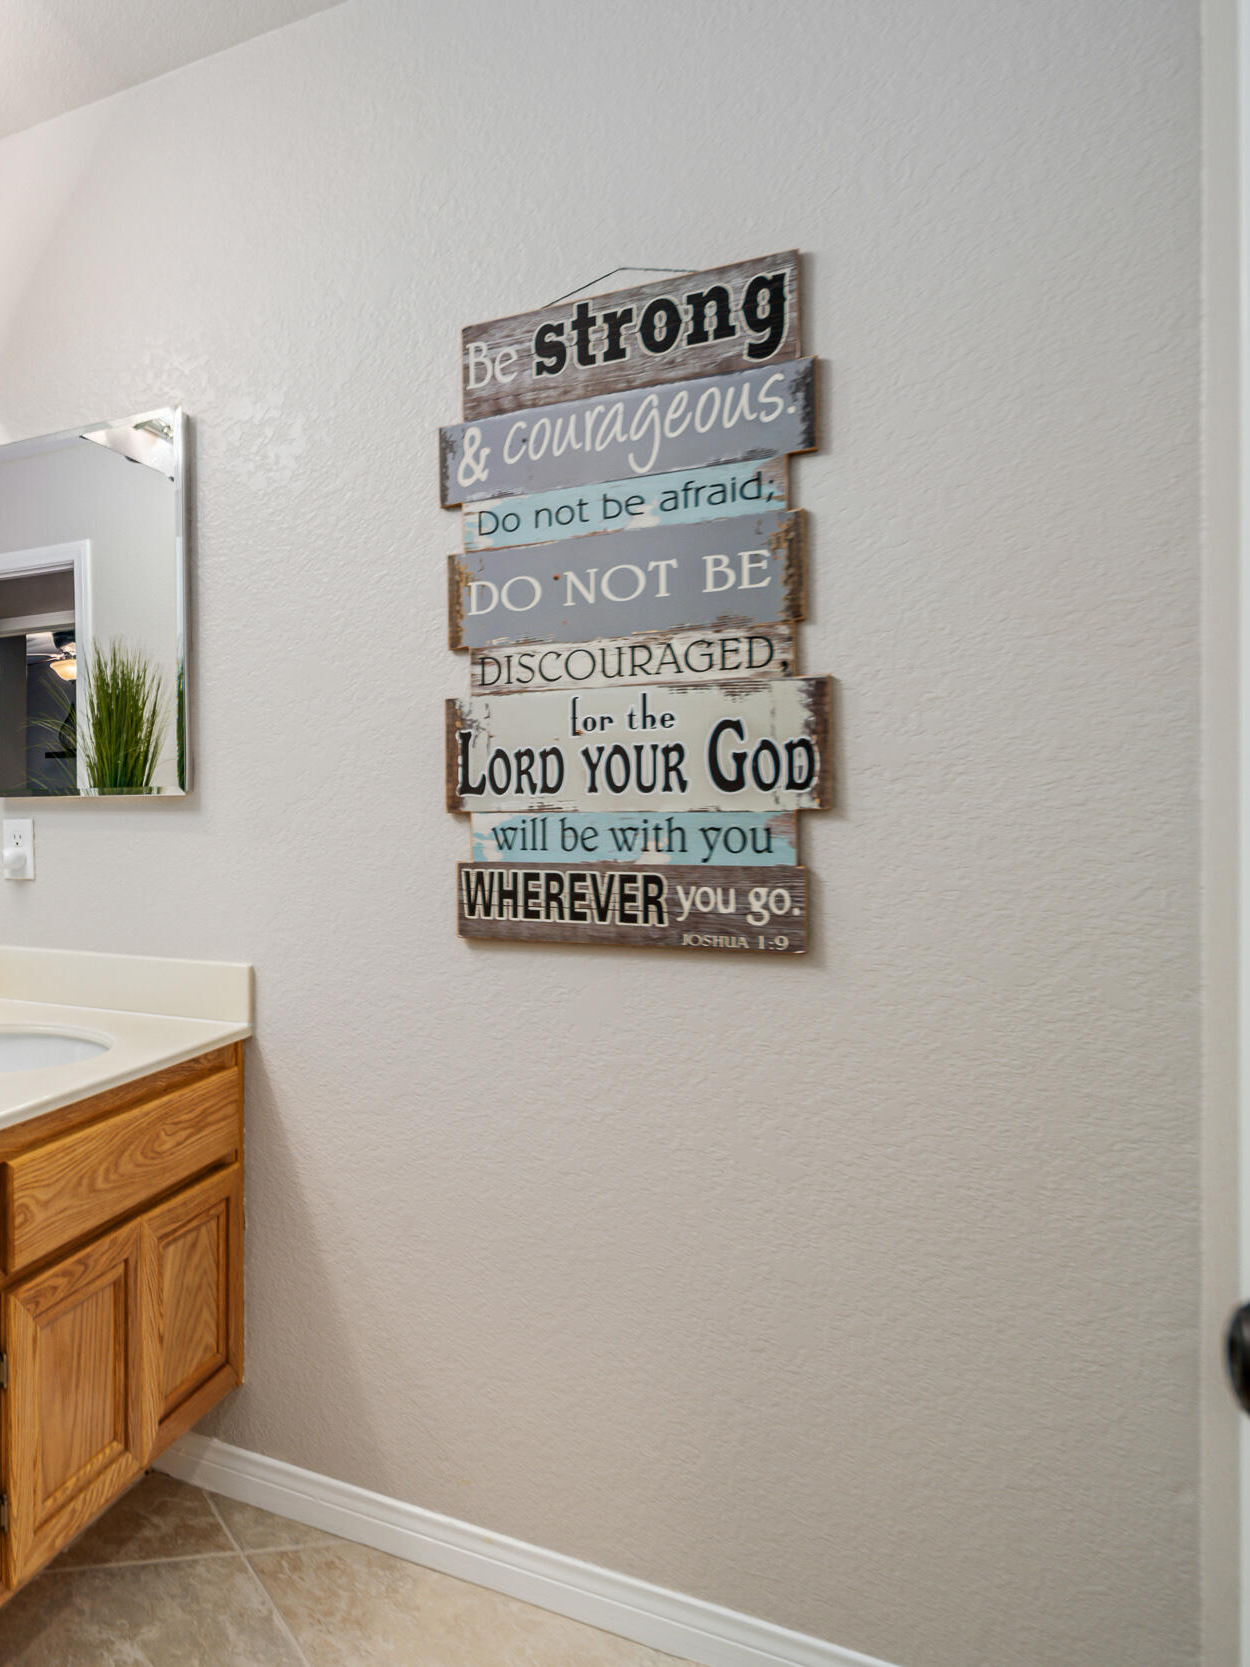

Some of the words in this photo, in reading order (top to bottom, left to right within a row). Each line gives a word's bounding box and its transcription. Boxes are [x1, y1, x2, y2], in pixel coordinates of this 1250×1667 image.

[465, 340, 518, 391] Be
[532, 268, 791, 379] strong
[457, 426, 490, 487] &
[503, 373, 796, 474] courageous.
[477, 510, 521, 537] Do
[534, 499, 589, 529] not
[602, 493, 645, 520] be
[659, 471, 775, 513] afraid;
[467, 575, 543, 616] DO
[563, 558, 678, 607] NOT
[702, 548, 772, 593] BE
[478, 635, 789, 686] DISCOURAGED,
[570, 696, 614, 737] for
[627, 692, 676, 730] the
[456, 730, 565, 796] LORD
[581, 741, 689, 794] YOUR
[706, 717, 819, 793] GOD
[492, 817, 547, 852] will
[560, 818, 599, 853] be
[609, 816, 687, 853] with
[700, 825, 773, 863] you
[461, 868, 669, 927] WHEREVER
[676, 885, 737, 921] you
[746, 884, 801, 926] go.
[682, 932, 750, 949] JOSHUA
[757, 934, 789, 951] 1:9
